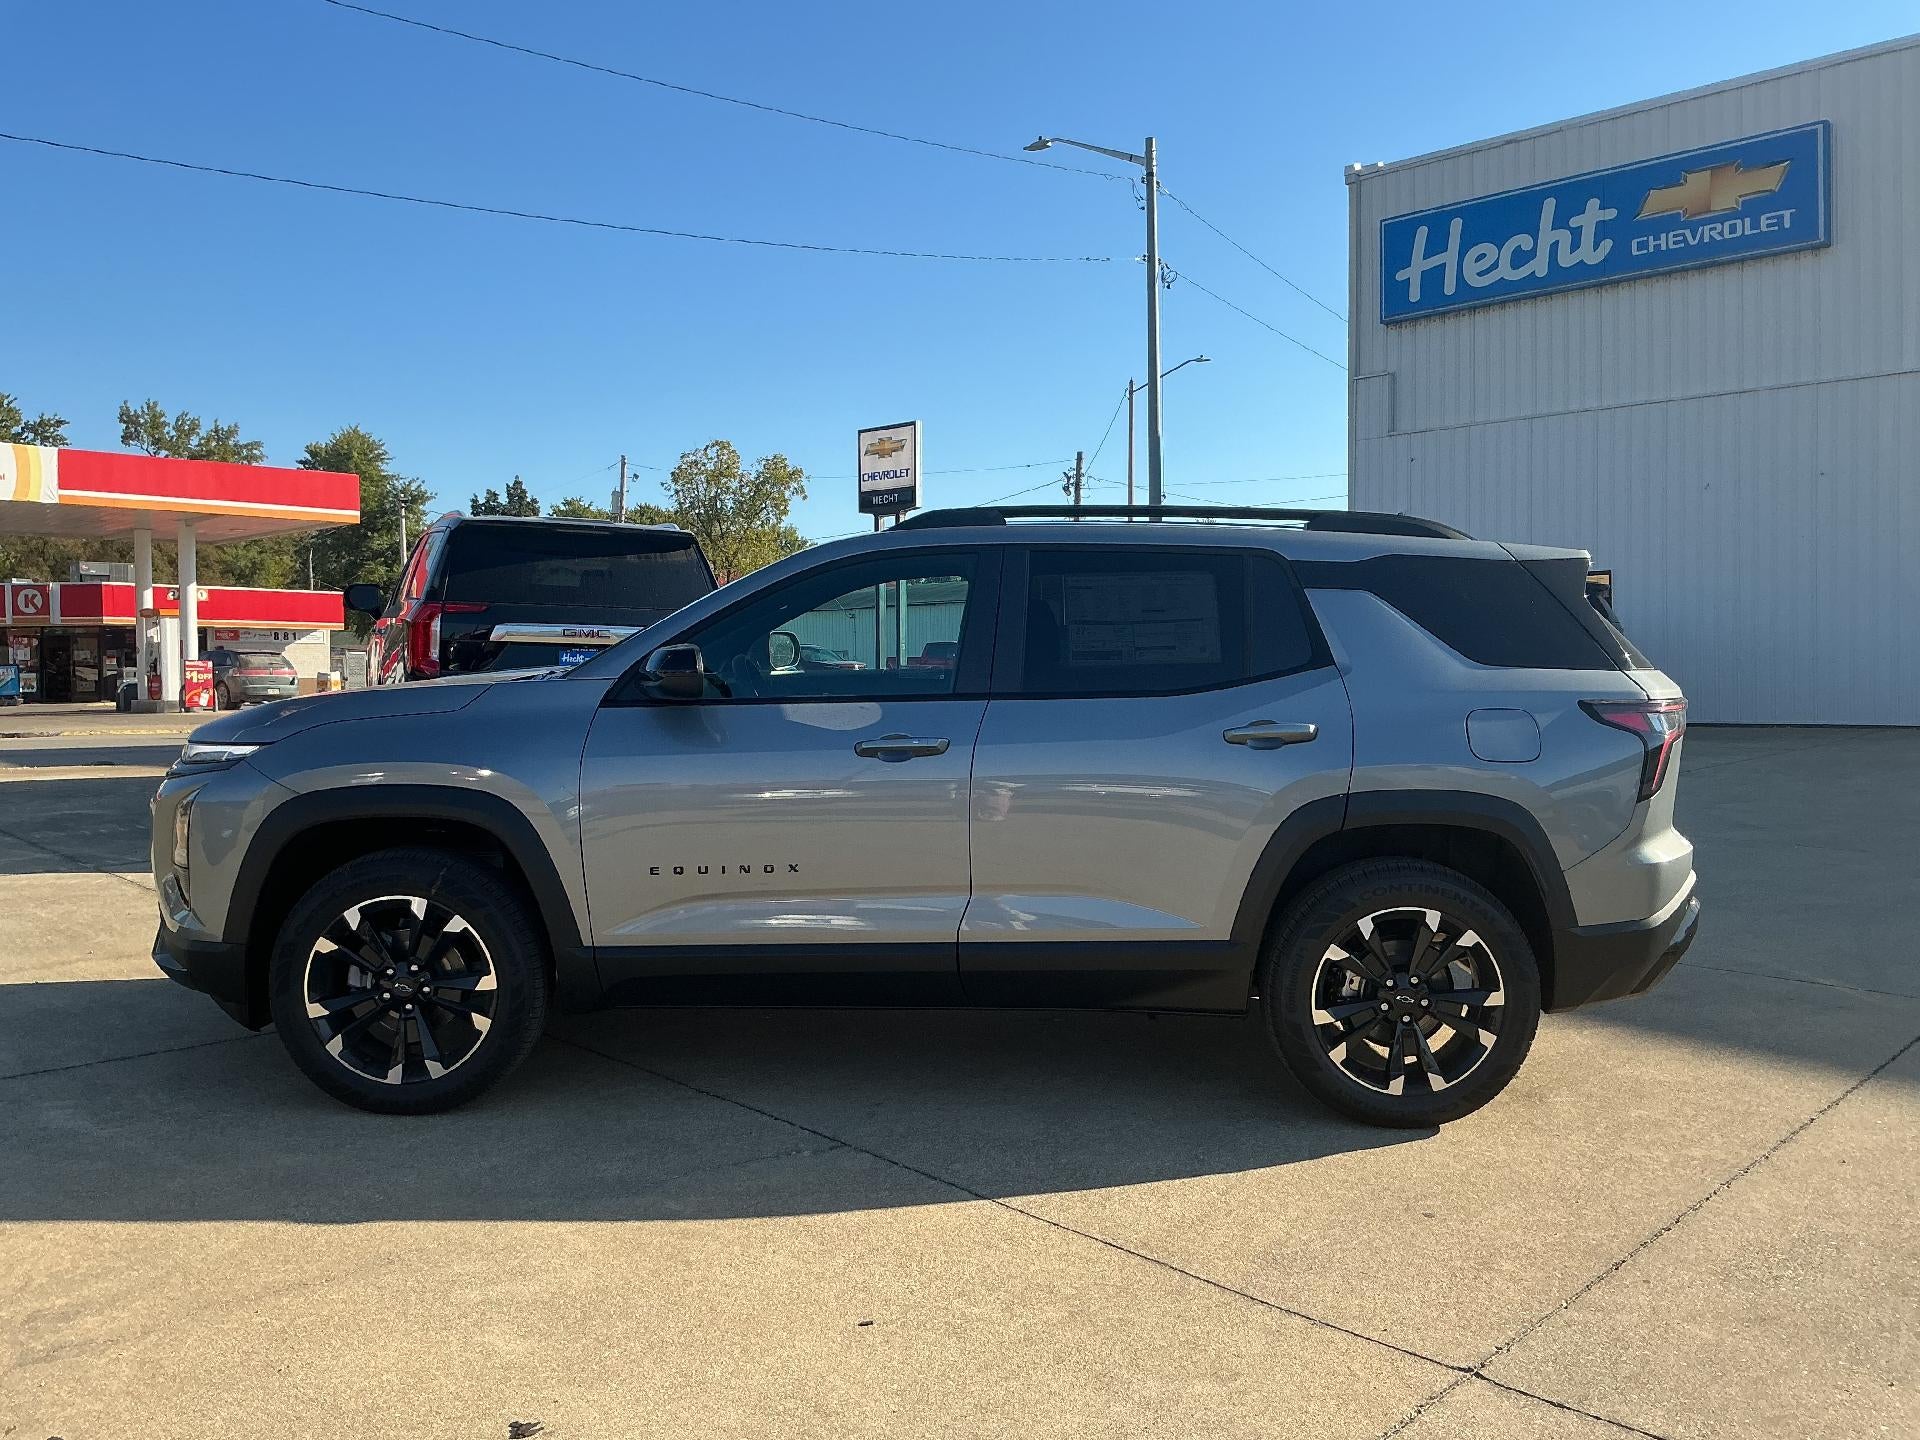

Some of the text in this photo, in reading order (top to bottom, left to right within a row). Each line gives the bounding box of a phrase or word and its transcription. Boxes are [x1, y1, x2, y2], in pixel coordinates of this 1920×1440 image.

[1631, 208, 1796, 256] CHEVROLET
[1395, 197, 1618, 303] Hecht
[862, 468, 910, 482] CHEVROLET
[872, 493, 899, 505] HECHT
[24, 593, 39, 611] K
[562, 628, 611, 639] GMC
[561, 652, 585, 663] Hecht
[649, 863, 800, 876] EQUINOX
